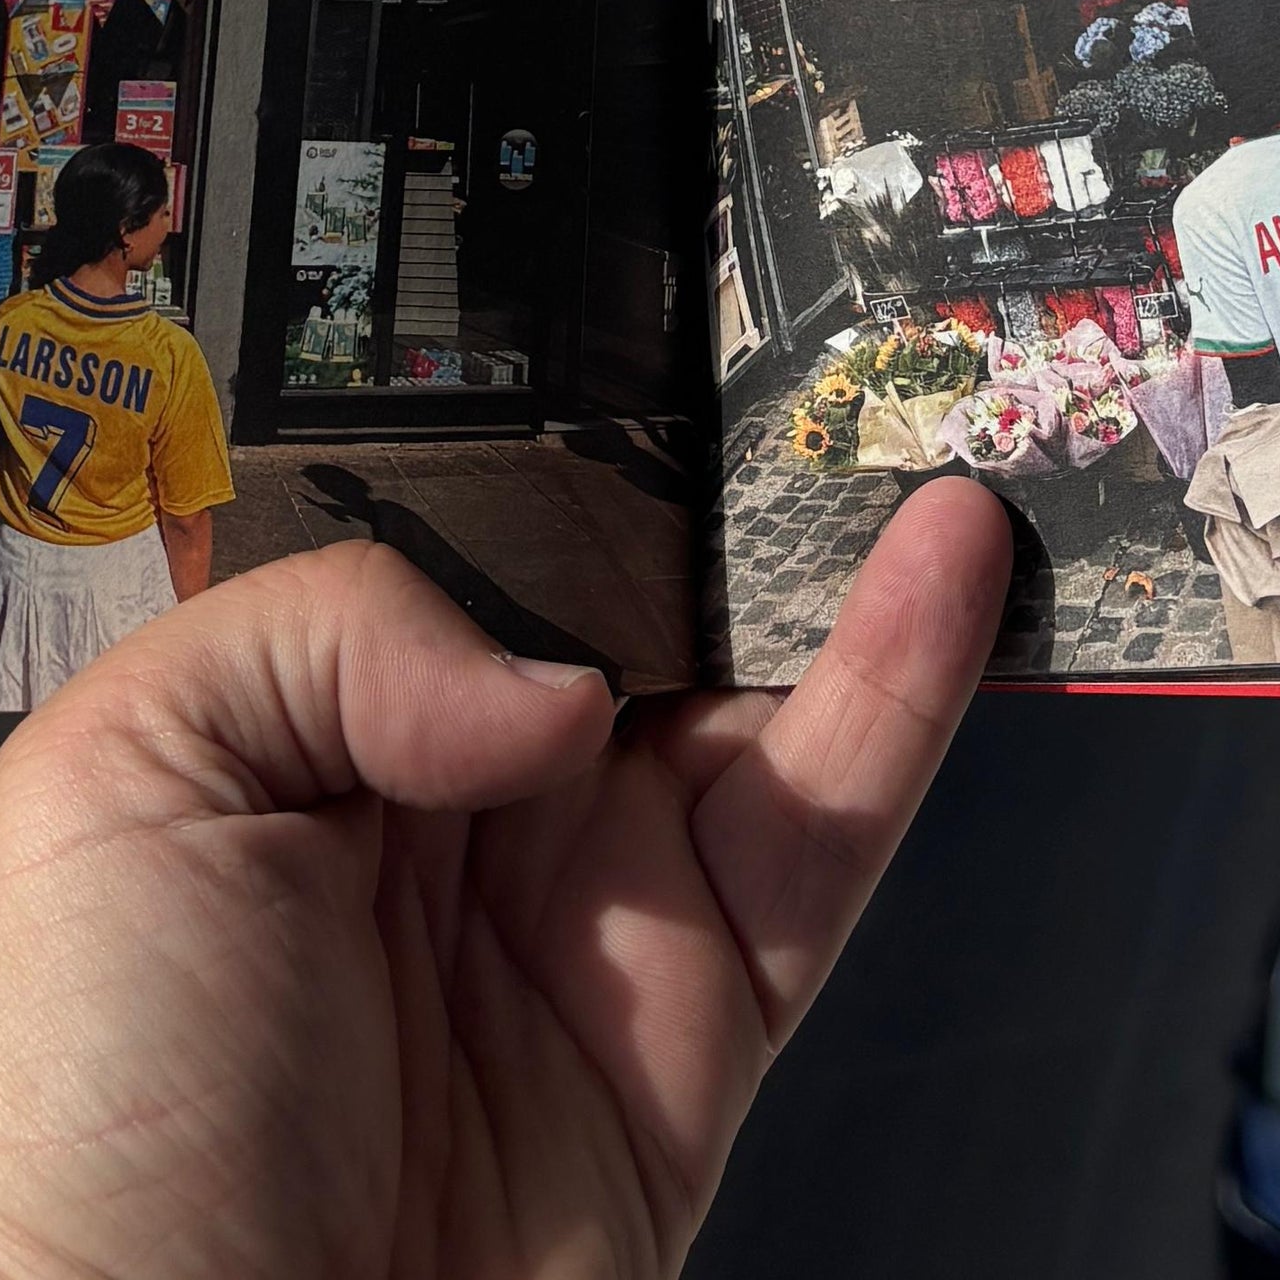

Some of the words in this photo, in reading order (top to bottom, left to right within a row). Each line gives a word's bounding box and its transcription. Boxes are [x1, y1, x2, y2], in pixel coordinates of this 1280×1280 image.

[125, 114, 138, 131] 3
[152, 115, 164, 131] 2
[20, 393, 98, 530] 7
